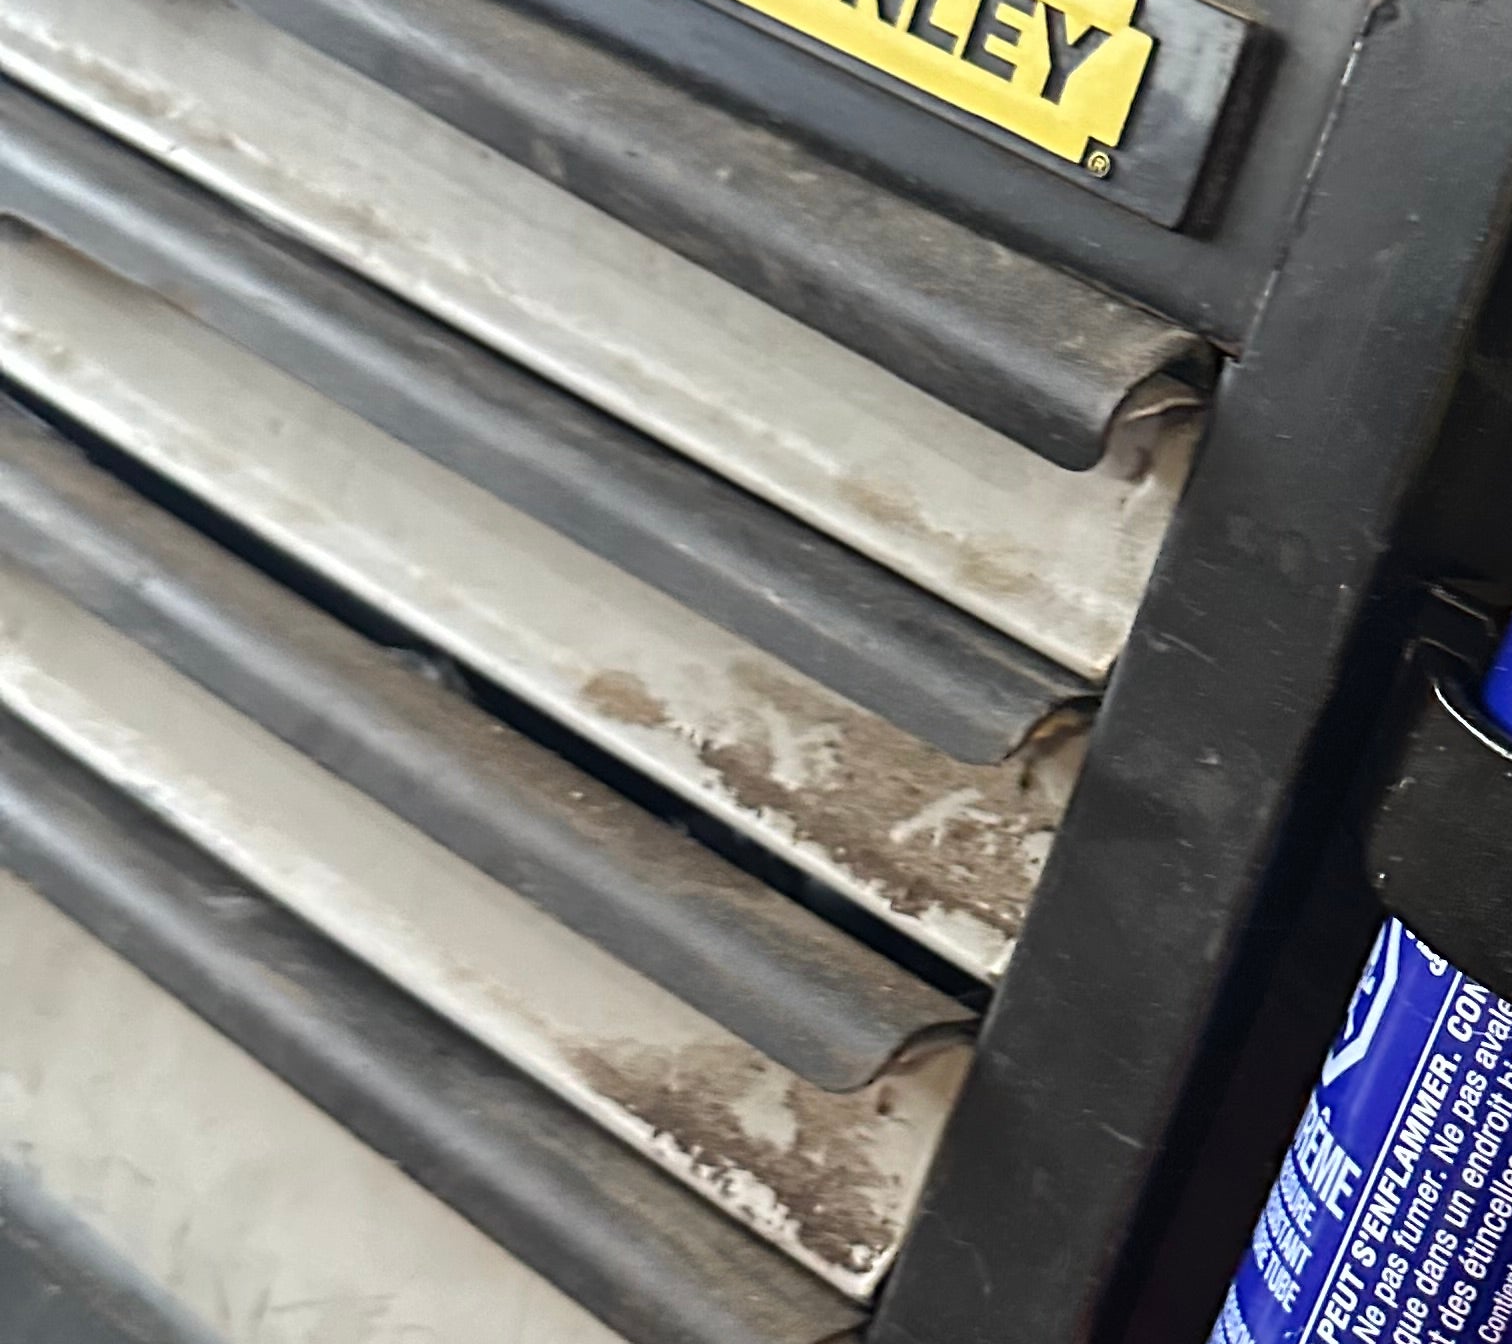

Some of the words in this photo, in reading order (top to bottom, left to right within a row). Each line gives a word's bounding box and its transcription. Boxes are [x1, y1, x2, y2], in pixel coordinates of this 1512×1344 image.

[1351, 1053, 1462, 1268] S'ENFLAMMER.
[1374, 1252, 1409, 1309] pas
[1392, 1169, 1448, 1253] fumer.
[1429, 1122, 1465, 1165] Ne
[1451, 1069, 1488, 1126] pas
[1413, 1229, 1458, 1296] dans
[1443, 1190, 1476, 1228] un
[1437, 1280, 1477, 1332] des
